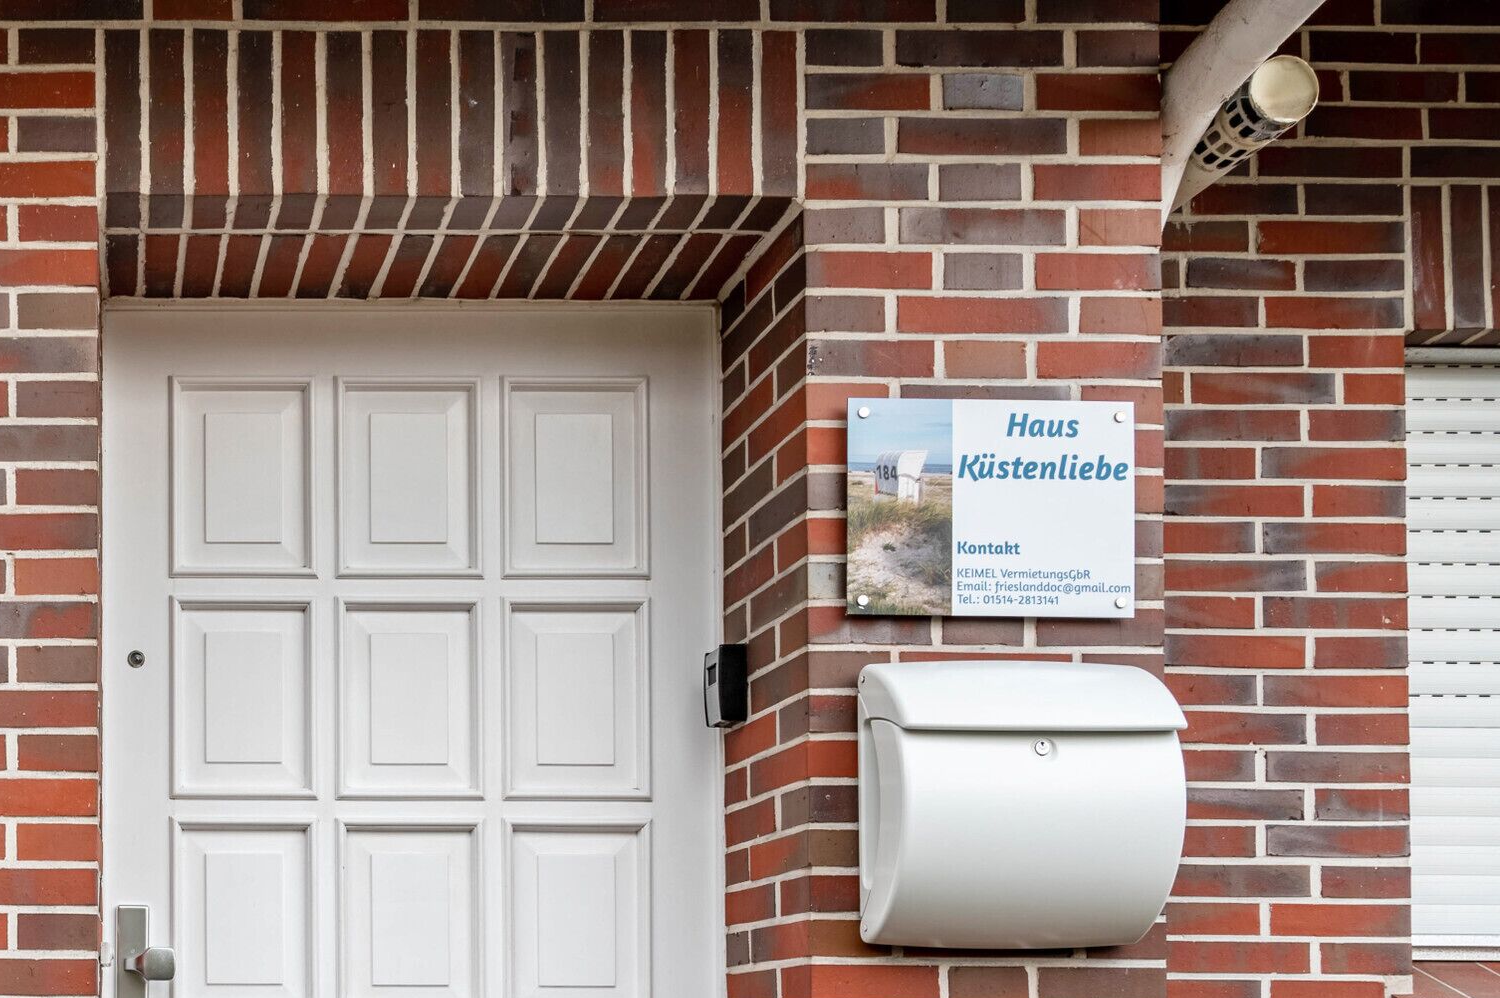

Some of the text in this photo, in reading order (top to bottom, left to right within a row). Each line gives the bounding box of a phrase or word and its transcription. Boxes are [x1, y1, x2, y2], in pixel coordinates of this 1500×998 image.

[1006, 412, 1079, 438] Haus
[876, 465, 898, 481] 184
[958, 453, 1128, 481] Küstenliebe
[956, 540, 1021, 556] Kontakt
[956, 568, 1091, 581] KEIMEL VermietungsGbR
[956, 581, 1132, 595] Email: frieslanddoc@gmail.com
[957, 594, 1060, 606] Tel.: 01514-2813141
